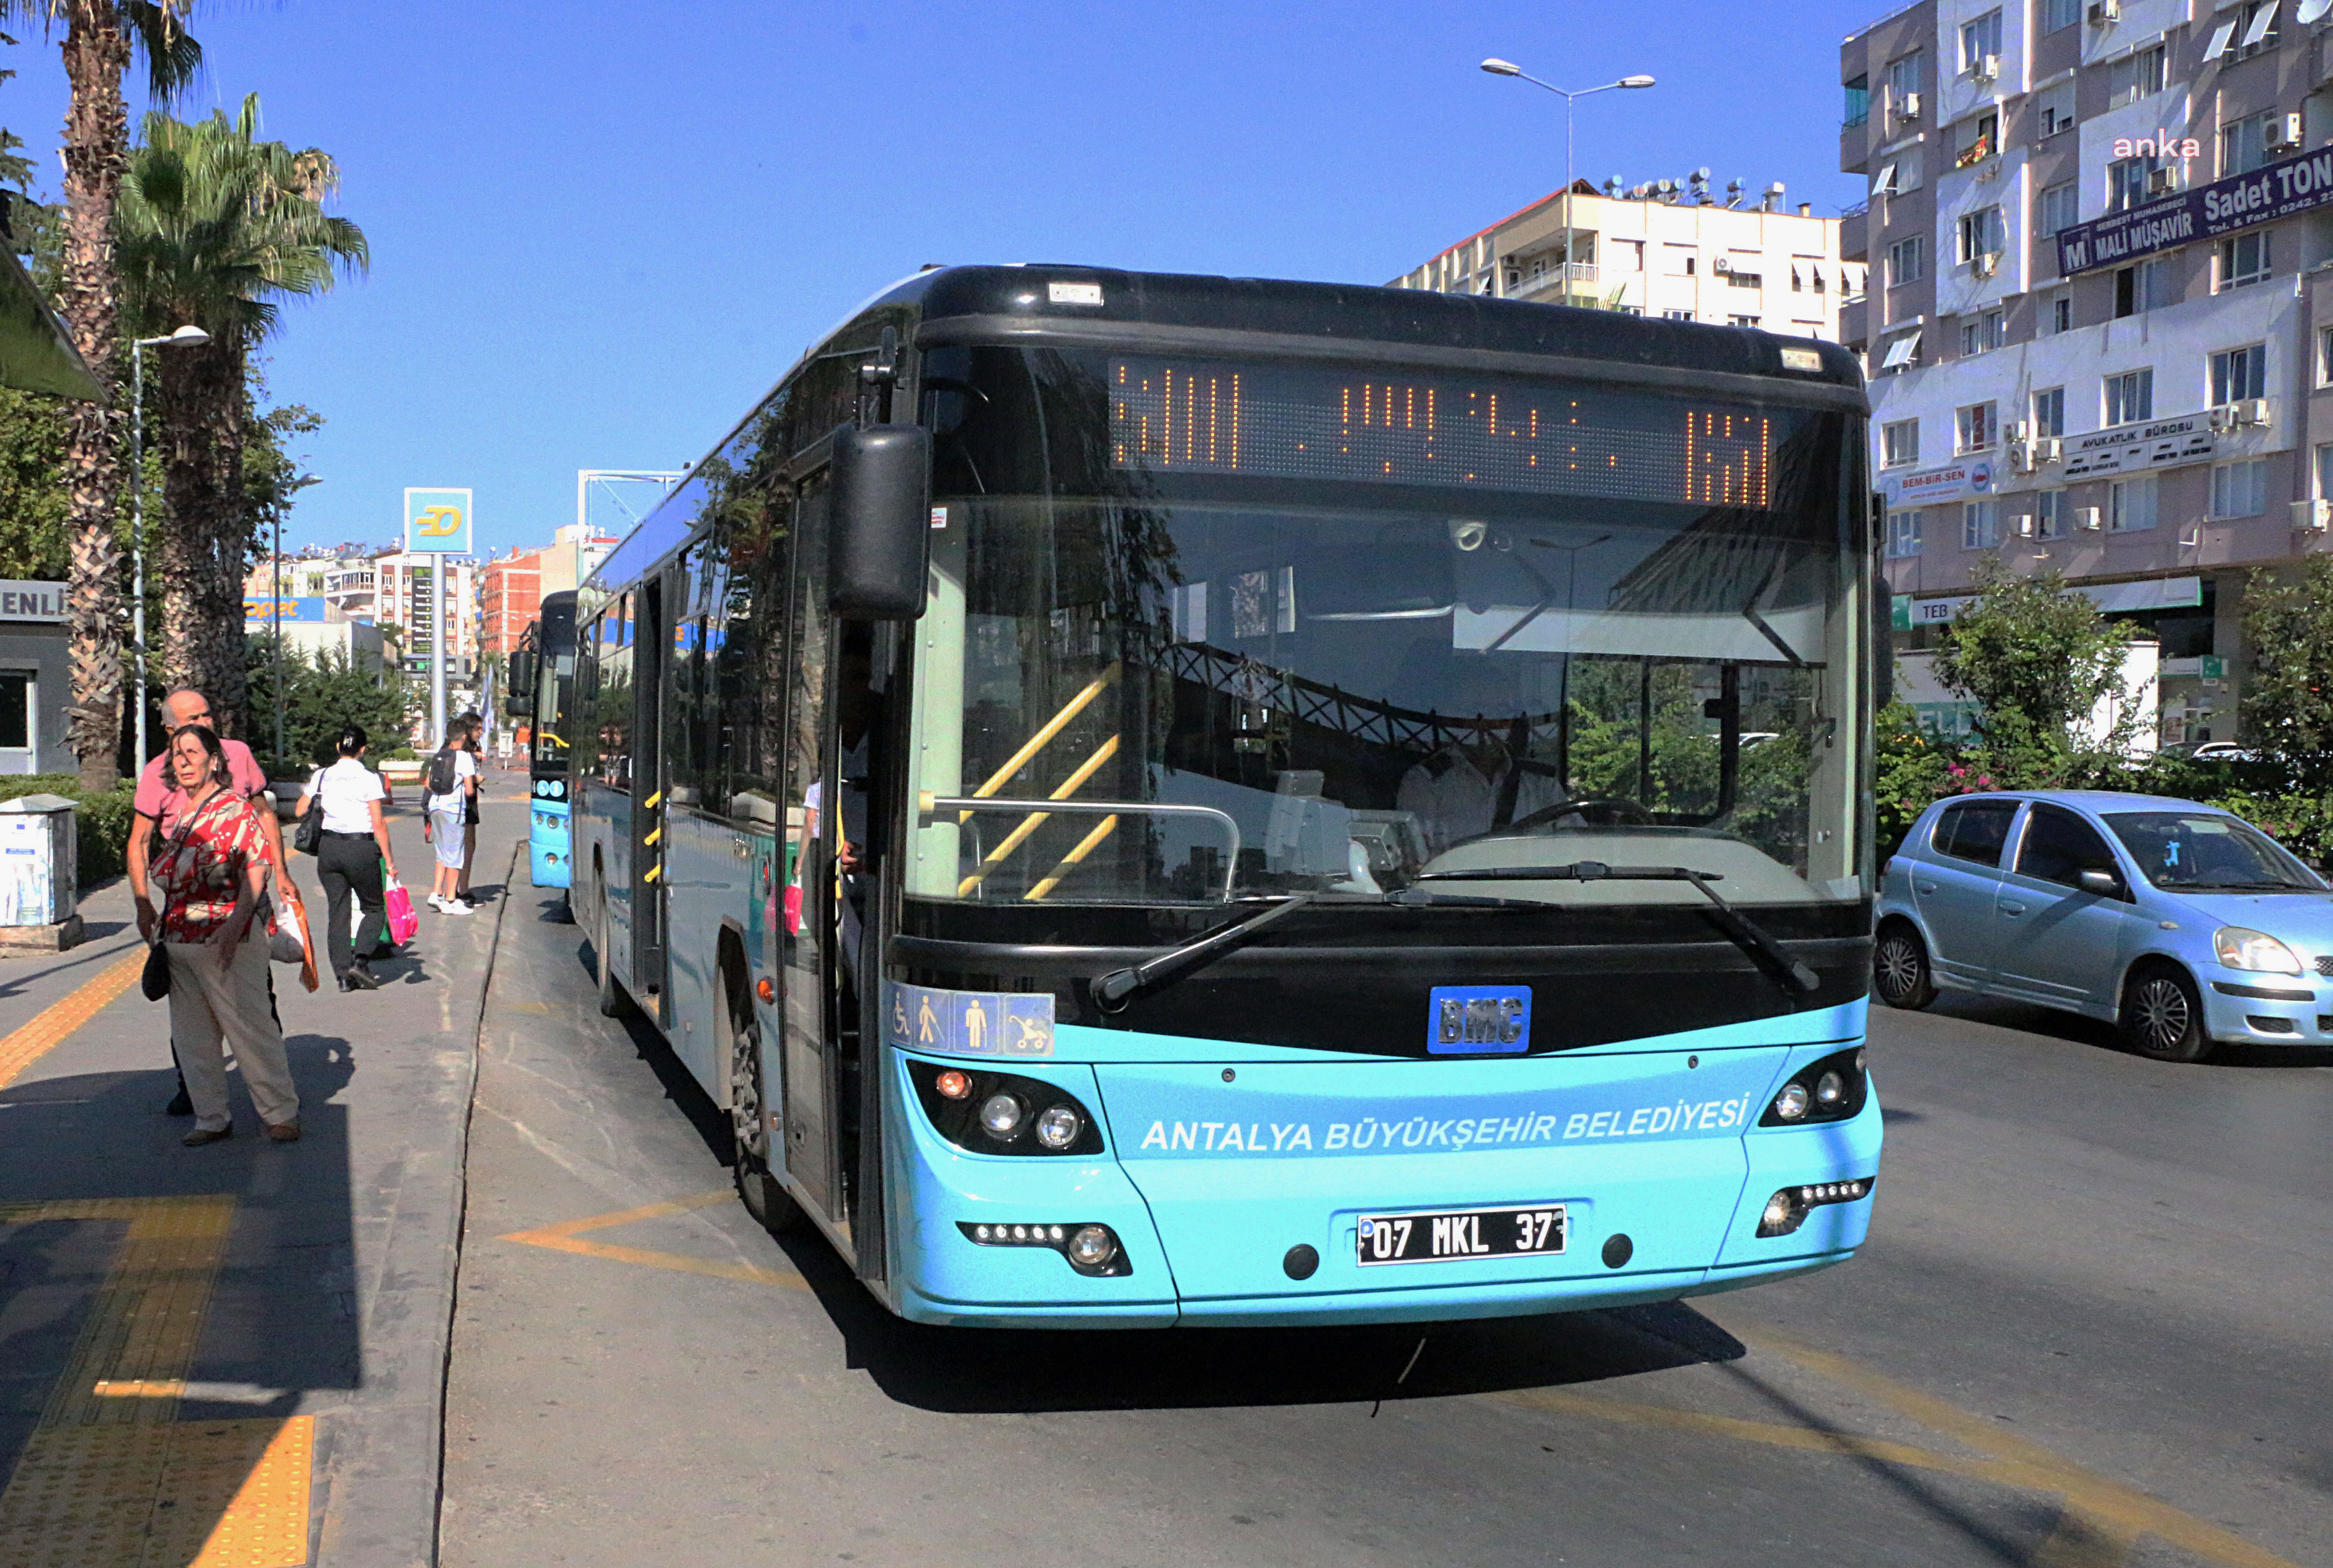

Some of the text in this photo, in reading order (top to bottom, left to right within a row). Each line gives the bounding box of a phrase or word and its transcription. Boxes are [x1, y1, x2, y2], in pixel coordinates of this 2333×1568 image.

[2205, 154, 2333, 221] Sadet TON
[2096, 208, 2193, 260] MALİ MÜŞAVİR
[2082, 431, 2137, 449] AVUKATLIK
[1923, 604, 1948, 618] TEB
[1439, 999, 1522, 1044] BMC
[1141, 1092, 1751, 1151] ANTALYA BÜYÜKŞEHİR BELEDİYESİ
[1373, 1212, 1553, 1258] 07 MKL 37
